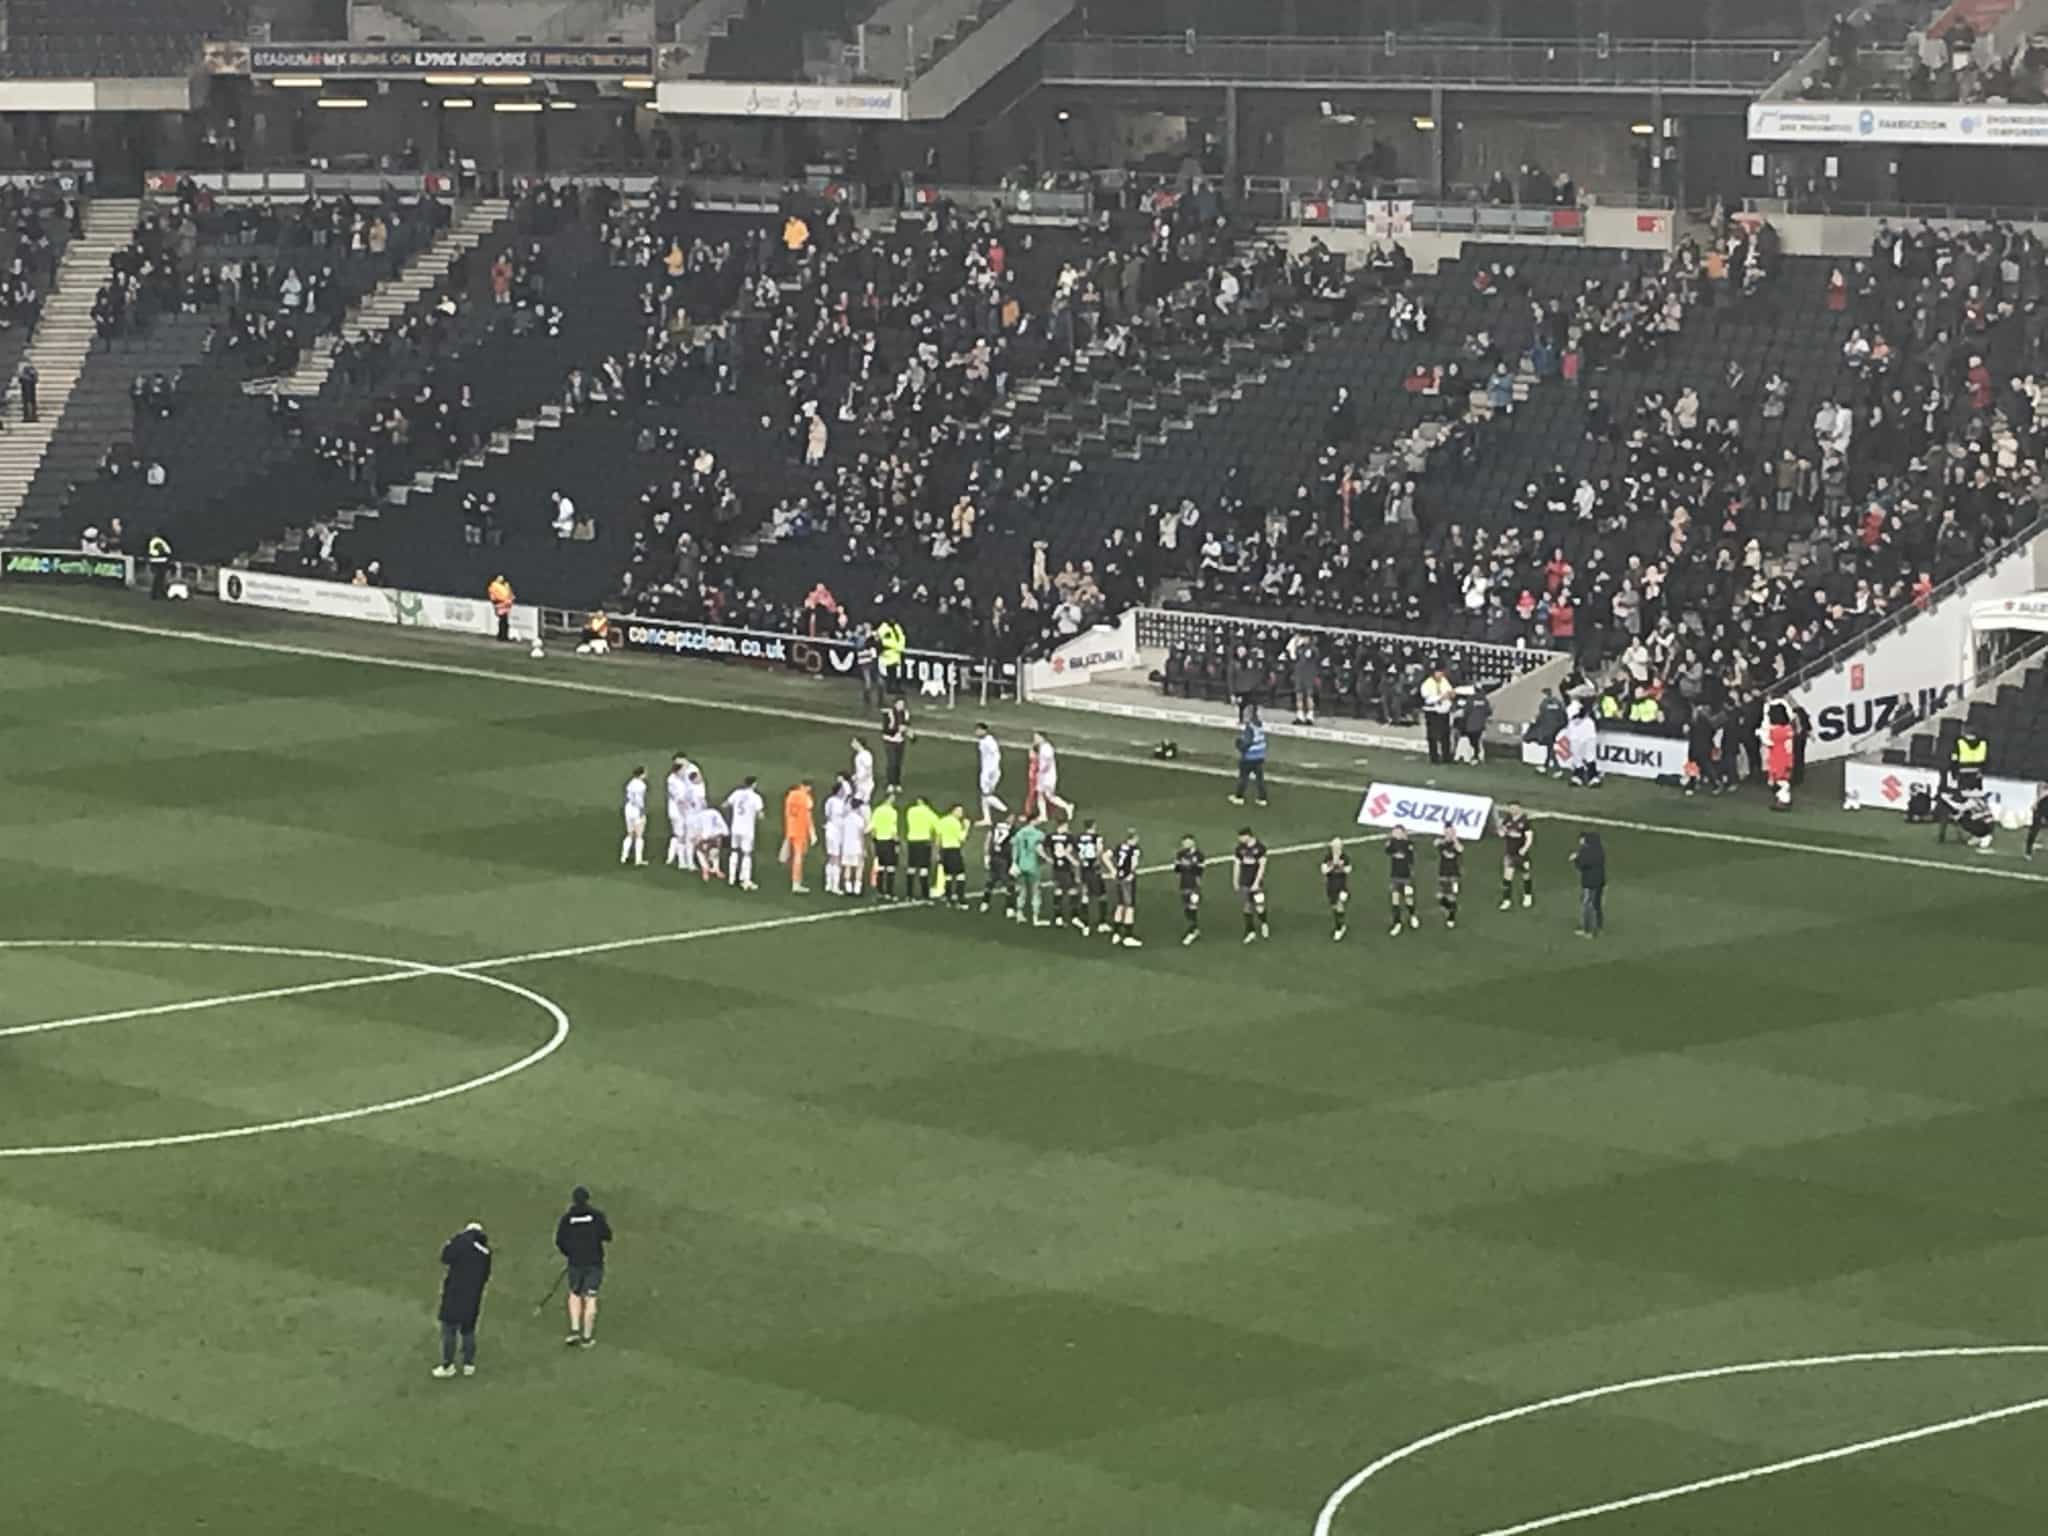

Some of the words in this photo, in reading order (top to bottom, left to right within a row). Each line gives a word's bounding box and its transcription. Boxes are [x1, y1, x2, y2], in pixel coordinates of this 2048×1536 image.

[628, 625, 786, 660] conceptclean.co.uk
[1069, 650, 1123, 669] SUZUKI
[1596, 743, 1663, 768] UZUKI
[1393, 800, 1483, 828] SUZUKI
